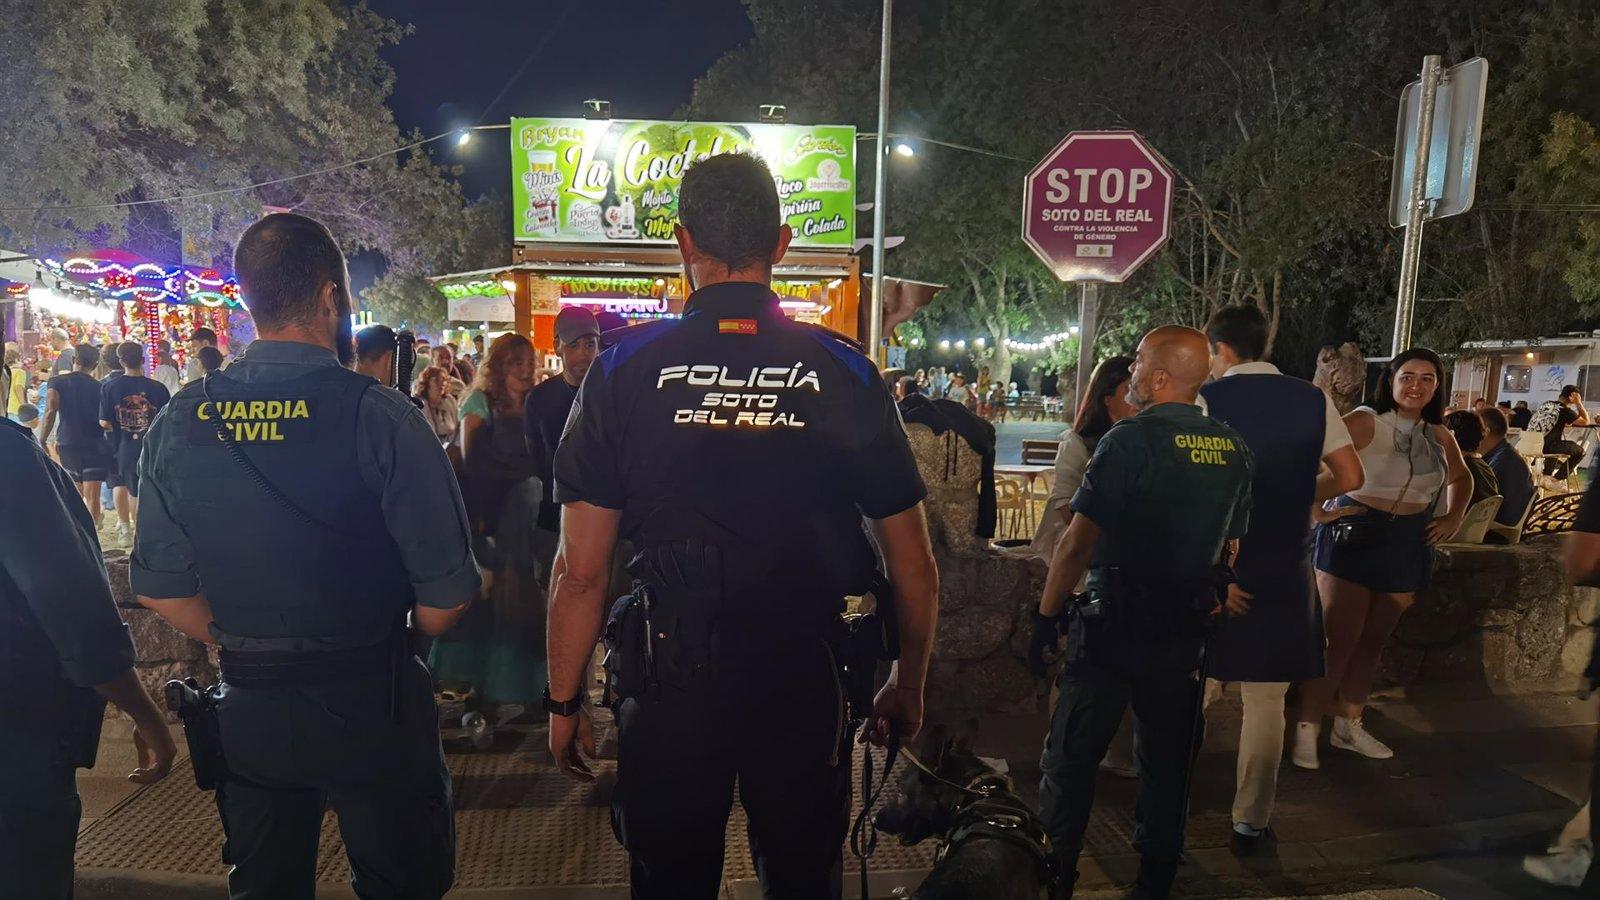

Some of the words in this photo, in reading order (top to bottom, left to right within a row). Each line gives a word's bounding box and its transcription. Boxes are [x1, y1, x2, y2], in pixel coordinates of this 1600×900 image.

[522, 126, 584, 148] Bryan
[565, 145, 611, 201] La
[774, 175, 803, 199] Loco
[1045, 168, 1153, 204] STOP
[780, 199, 821, 224] ipiriña
[1041, 209, 1080, 222] SOTO
[1084, 209, 1112, 222] DEL
[1115, 209, 1153, 222] REAL
[804, 215, 845, 235] Colada
[656, 361, 821, 392] POLICÍA
[701, 392, 778, 408] SOTO
[673, 409, 728, 425] DEL
[734, 411, 806, 427] REAL
[1174, 434, 1235, 451] GUARDIA
[1190, 448, 1227, 465] CIVIL
